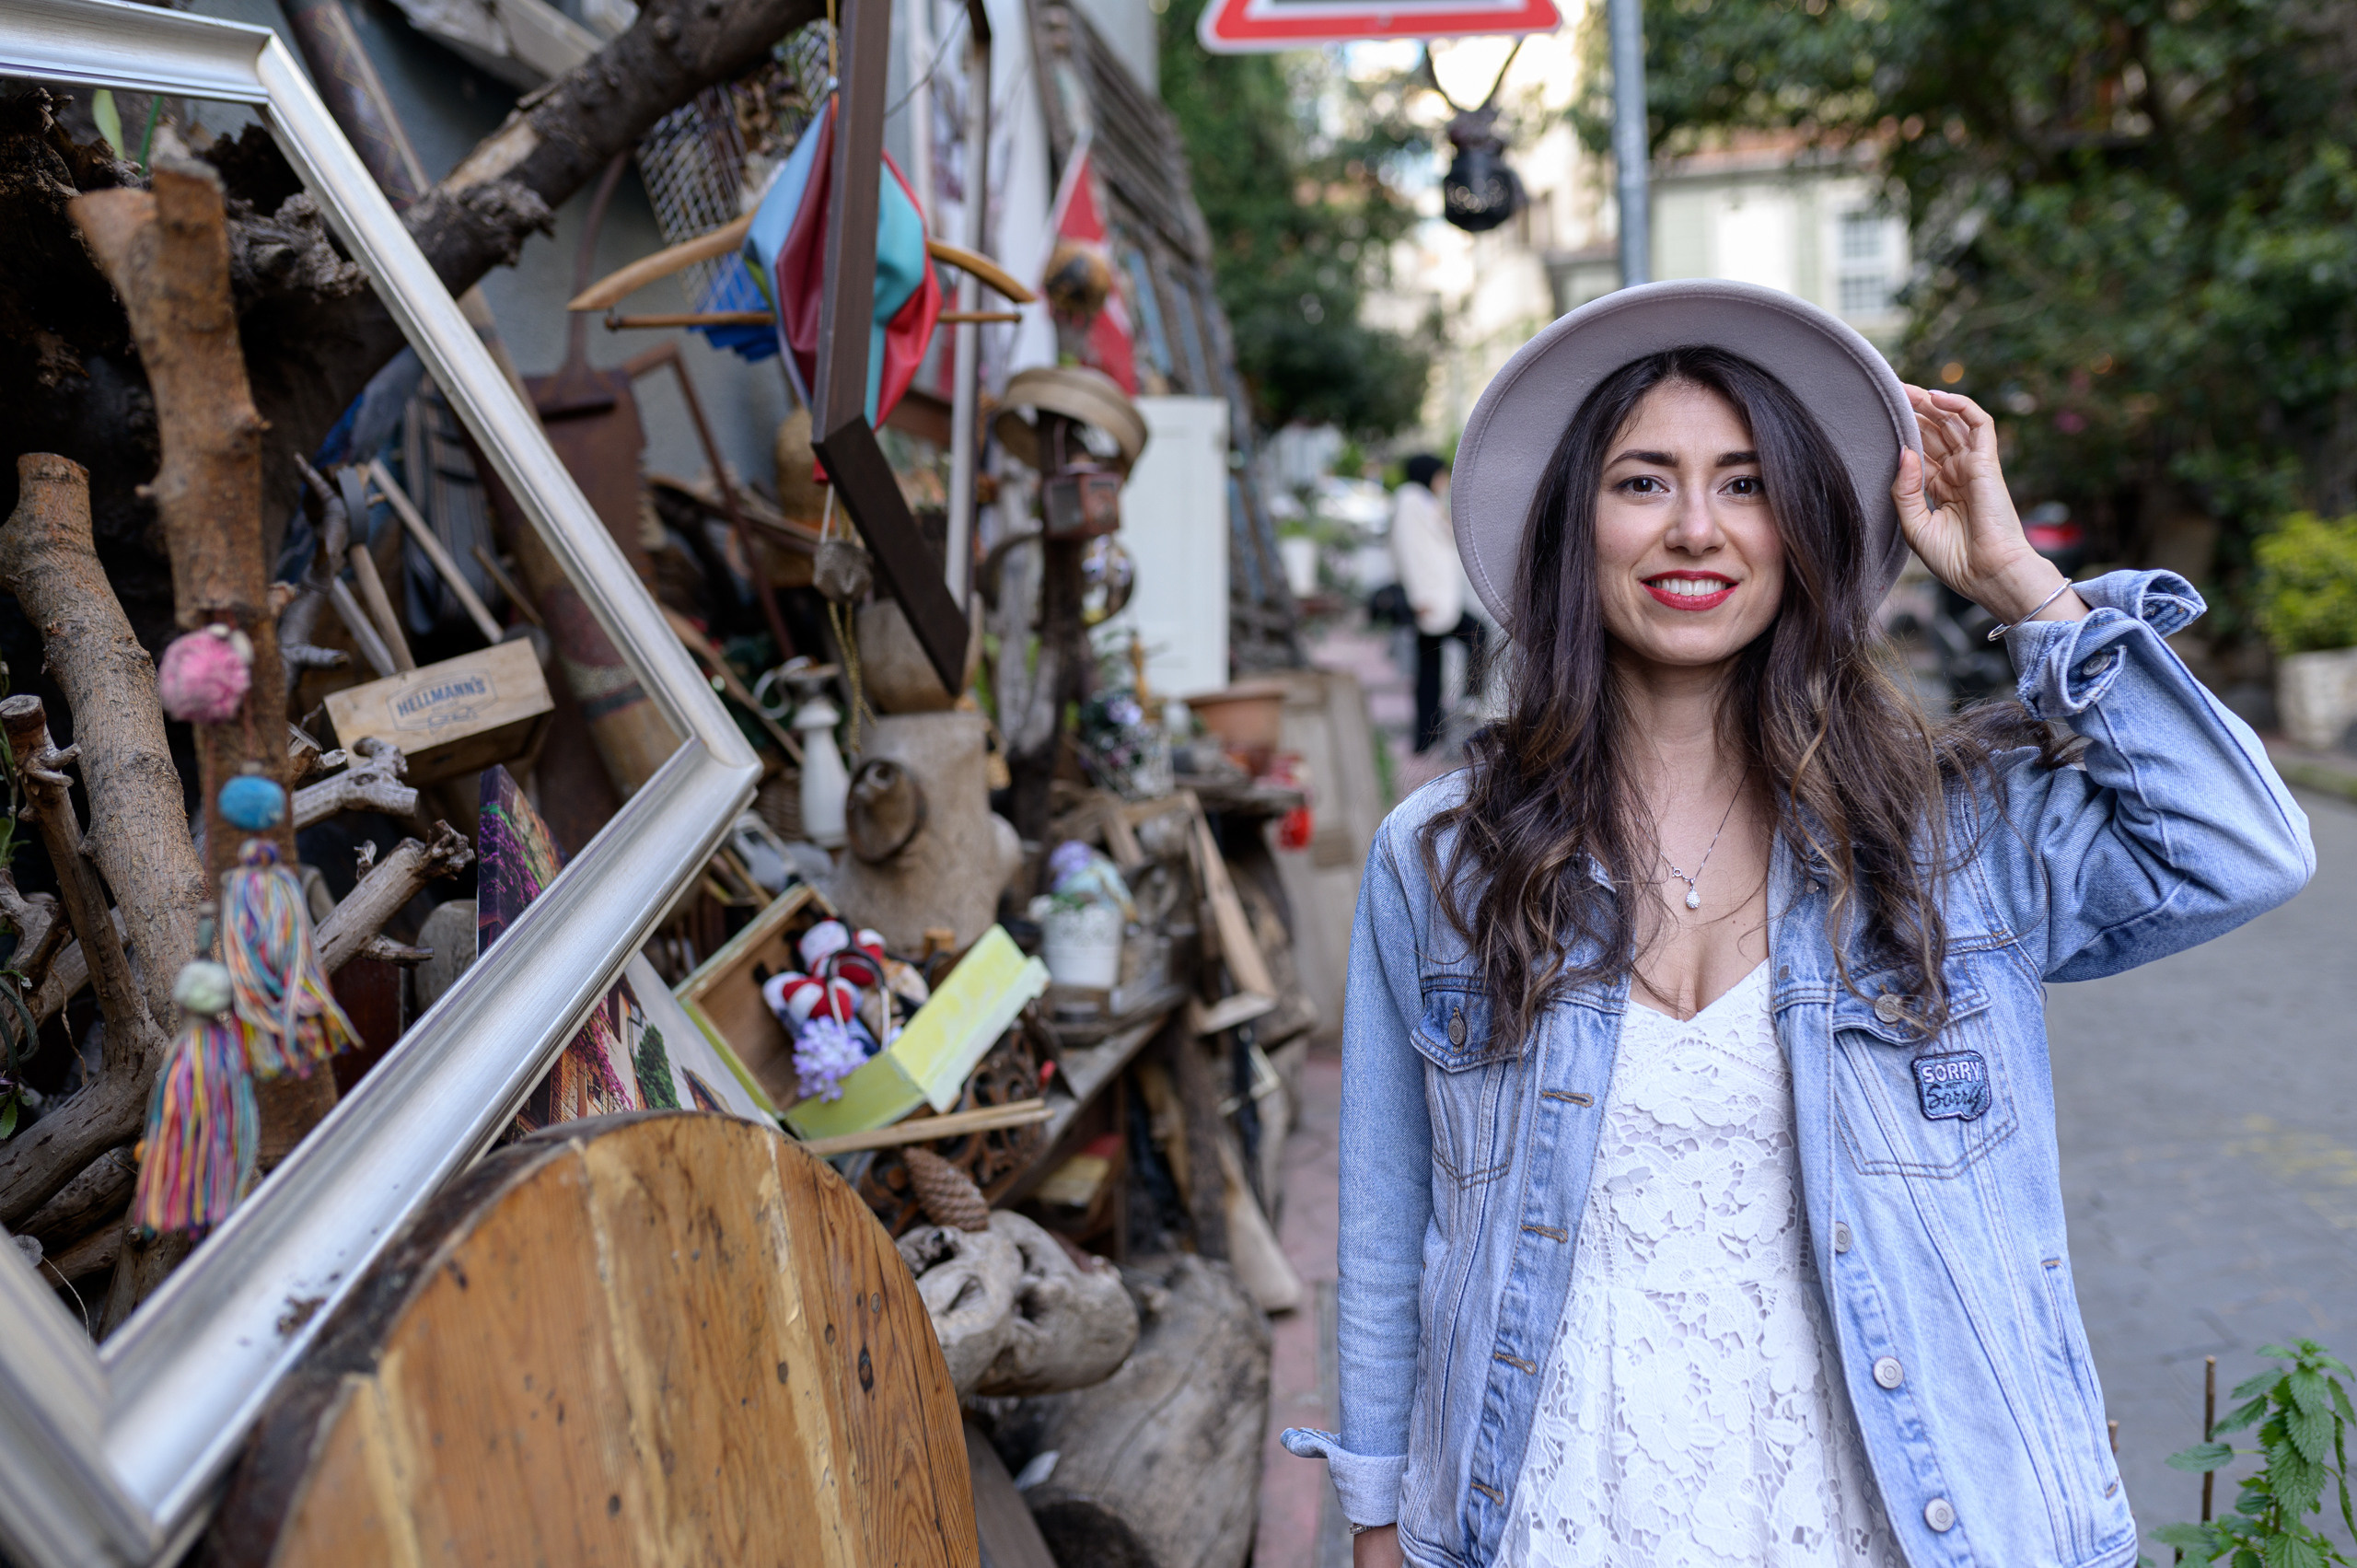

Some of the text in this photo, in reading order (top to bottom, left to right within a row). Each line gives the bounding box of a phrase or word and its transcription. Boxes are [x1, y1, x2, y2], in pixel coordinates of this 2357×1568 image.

[397, 676, 486, 716] HELLMANN'S
[1922, 1061, 1980, 1083] SORRY
[1926, 1084, 1985, 1112] Sorry
